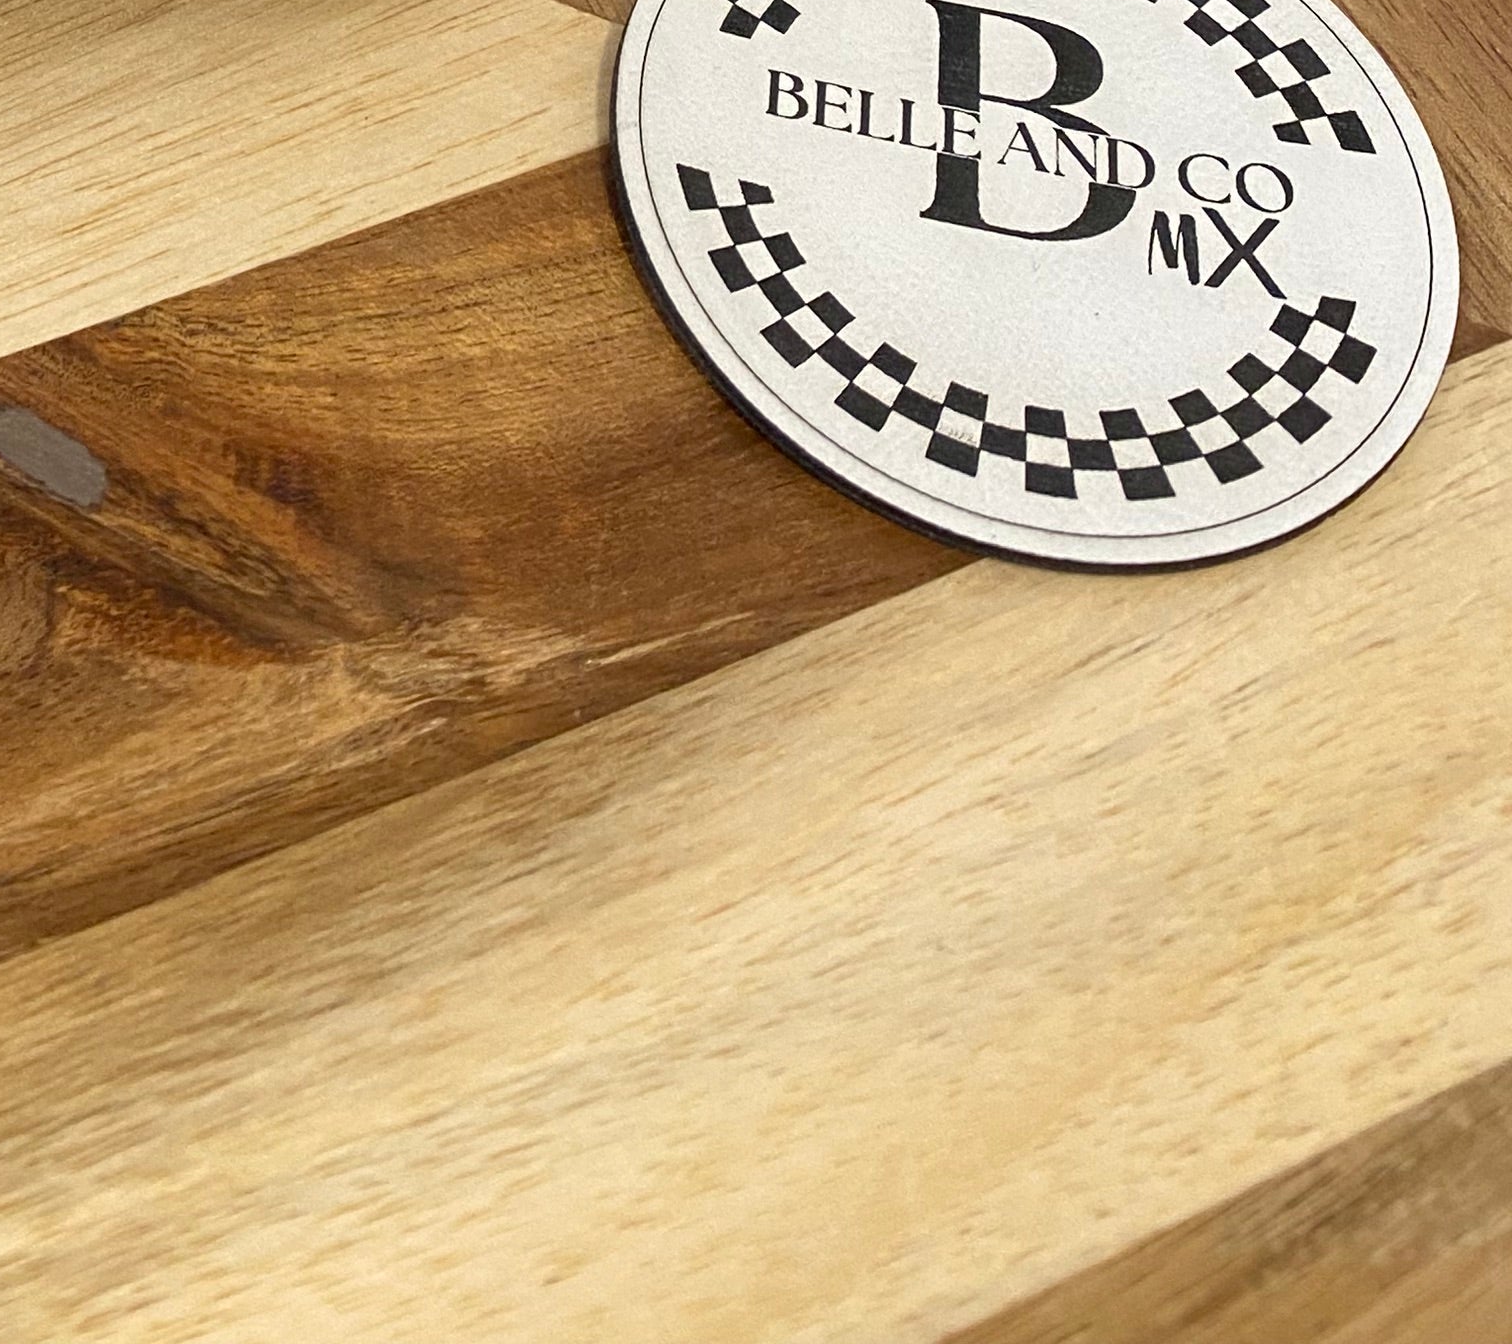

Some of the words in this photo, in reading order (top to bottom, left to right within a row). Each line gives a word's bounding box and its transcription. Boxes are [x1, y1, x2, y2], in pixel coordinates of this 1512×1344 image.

[765, 68, 982, 161] BELLE
[997, 121, 1156, 190] AND
[1178, 153, 1293, 214] CO
[1148, 207, 1288, 300] MX
